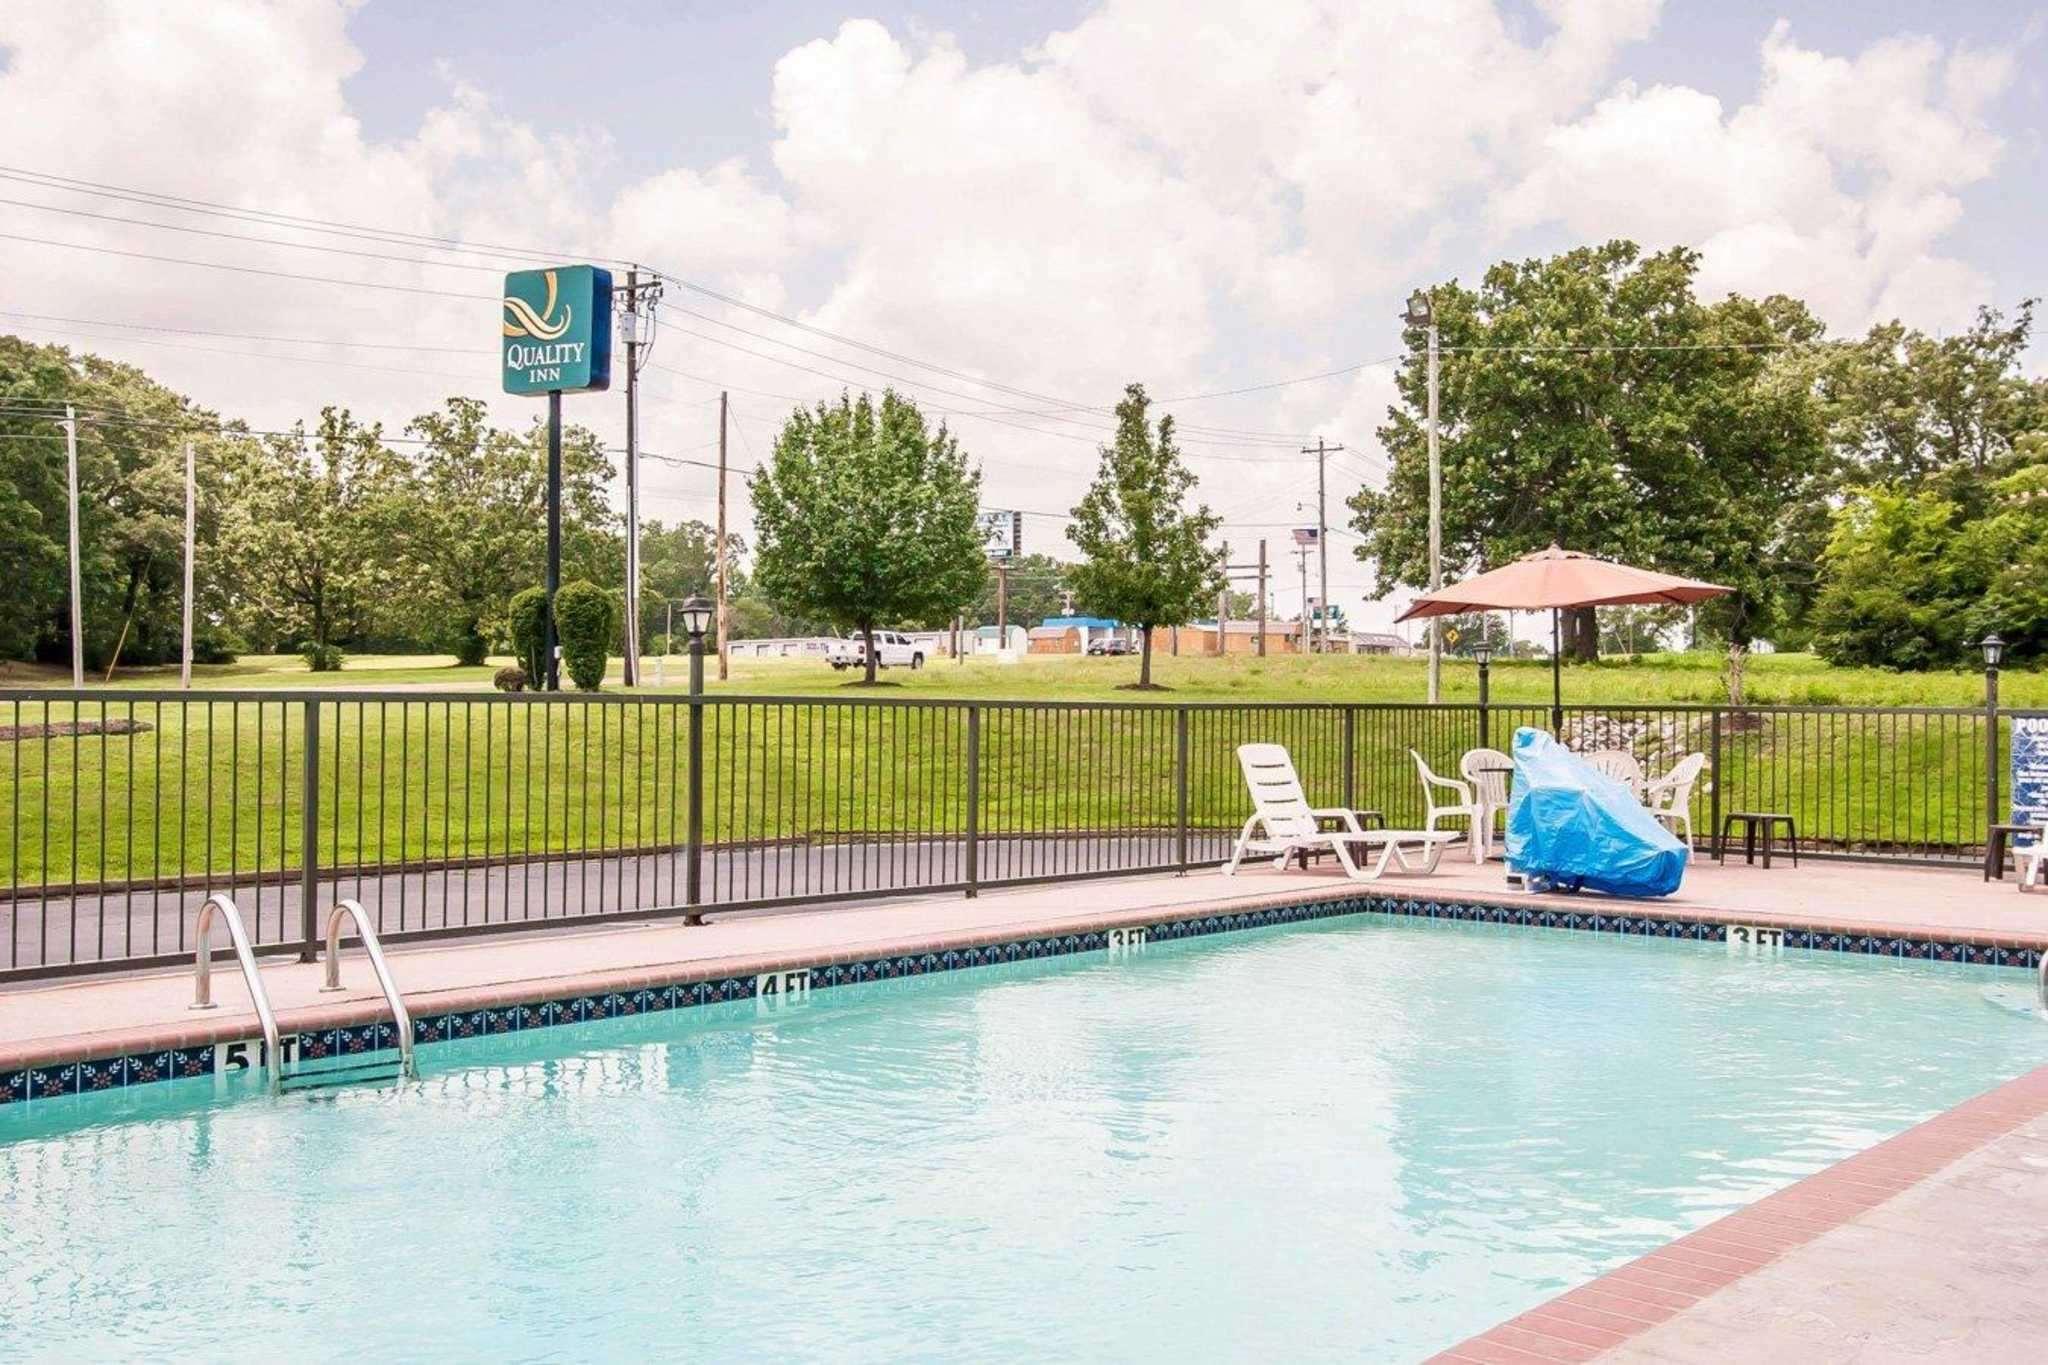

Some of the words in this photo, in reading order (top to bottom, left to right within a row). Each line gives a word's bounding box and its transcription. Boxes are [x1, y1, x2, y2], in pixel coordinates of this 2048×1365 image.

[507, 342, 585, 370] QUALITY
[529, 367, 561, 383] INN
[1128, 928, 1144, 946] FT
[1756, 929, 1781, 946] FT
[762, 975, 778, 995] 4
[785, 971, 808, 993] FT
[224, 1043, 250, 1071] 5
